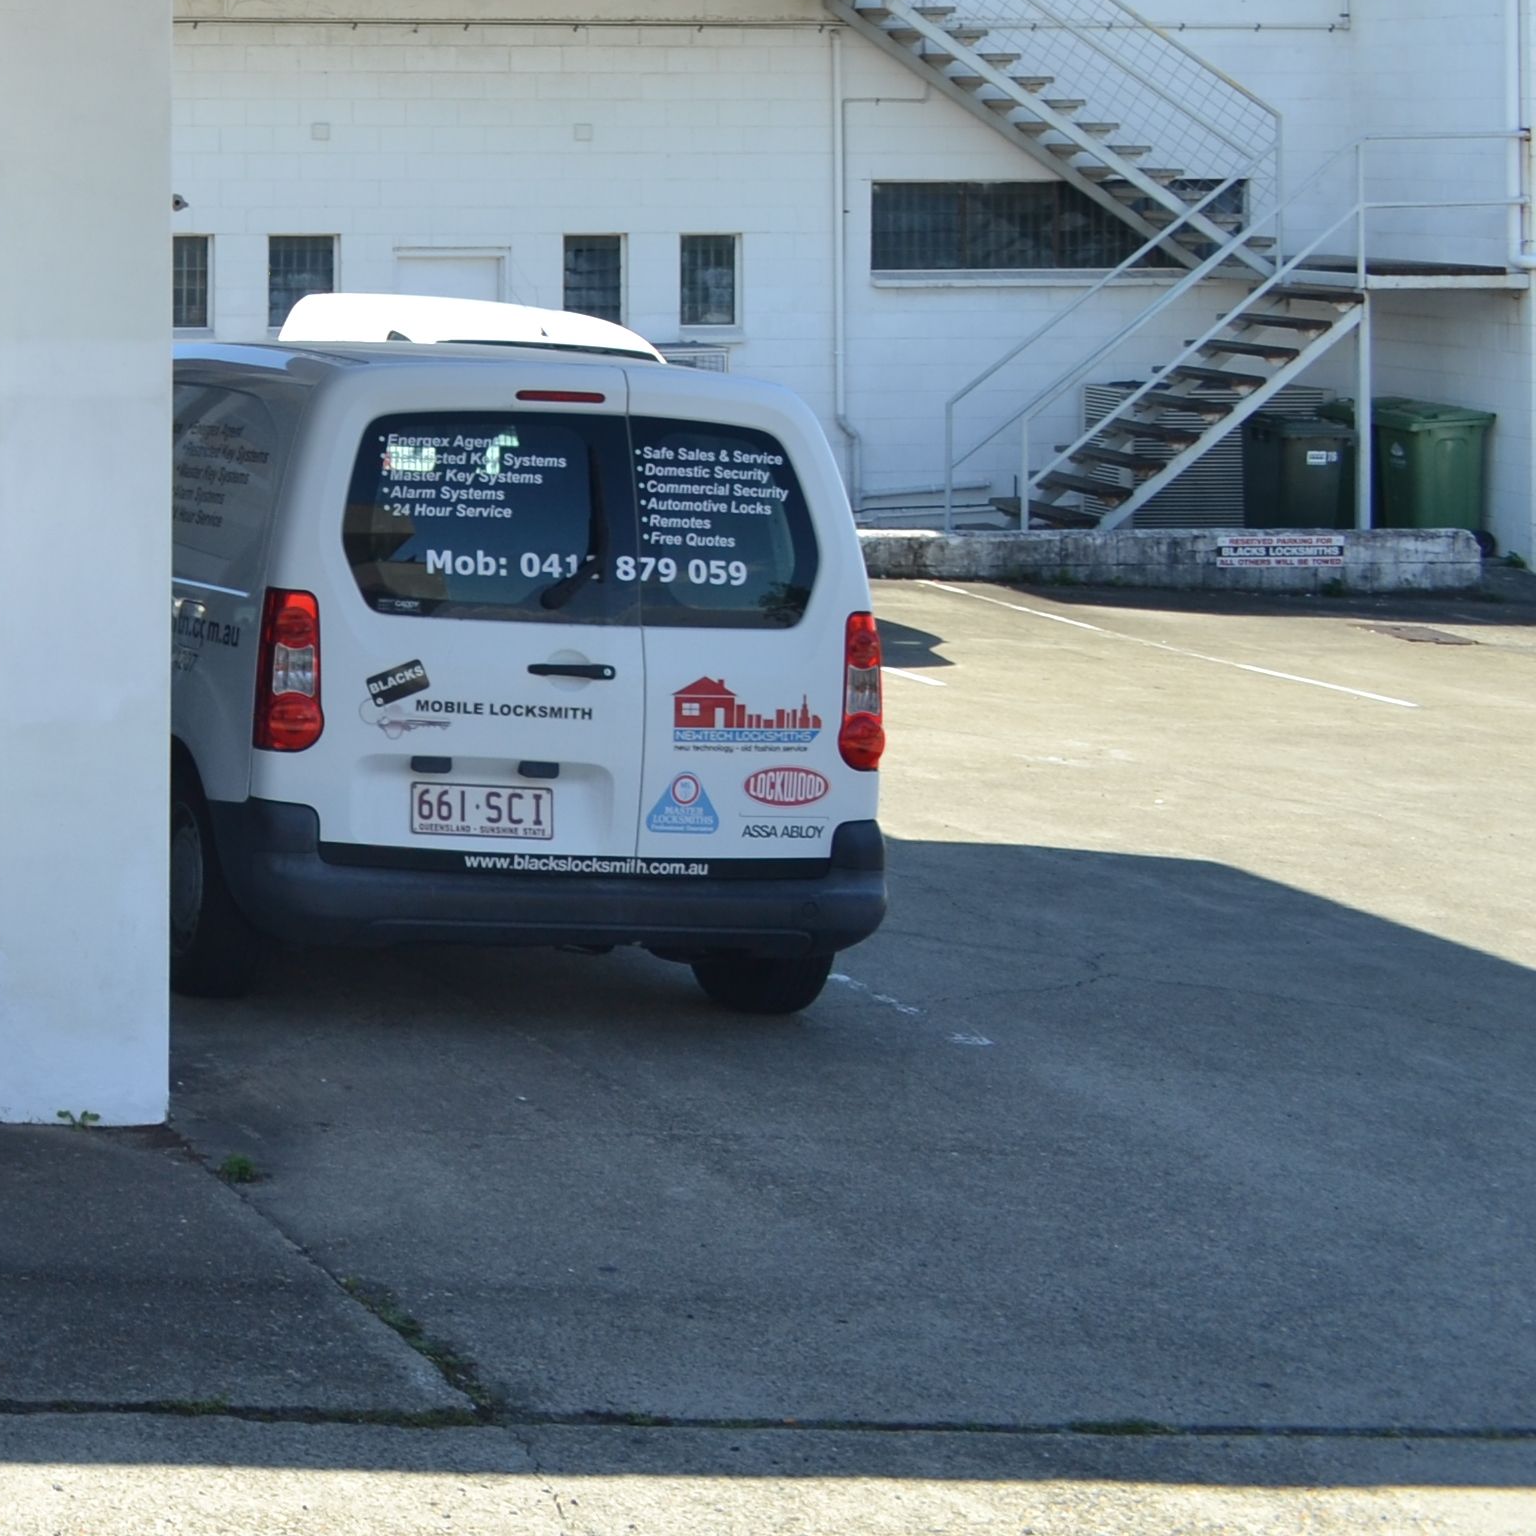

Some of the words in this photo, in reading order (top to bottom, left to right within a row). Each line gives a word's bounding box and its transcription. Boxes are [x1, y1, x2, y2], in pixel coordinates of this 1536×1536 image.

[387, 433, 450, 449] Energex
[503, 453, 568, 469] Systems
[642, 446, 675, 460] Safe
[677, 447, 716, 462] Sales
[718, 449, 730, 463] &
[732, 450, 784, 466] Service
[389, 468, 442, 482] Master
[445, 468, 476, 485] Key
[478, 469, 544, 486] Systems
[644, 463, 711, 478] Domestic
[713, 465, 771, 484] Security
[389, 485, 436, 499] Alarm
[439, 486, 506, 502] Systems
[646, 479, 730, 496] Commercial
[732, 483, 789, 502] Security
[392, 503, 411, 516] 24
[414, 503, 453, 517] Hour
[455, 504, 514, 518] Service
[647, 497, 728, 513] Automotive
[730, 500, 773, 516] Locks
[649, 514, 712, 530] Remotes
[650, 531, 683, 546] Free
[685, 532, 737, 548] Quotes
[1221, 547, 1266, 556] BLACKS
[1269, 547, 1340, 556] LOCKSMITHS
[426, 549, 508, 577] Mob:
[520, 551, 600, 580] 041
[615, 555, 678, 583] 879
[687, 559, 748, 586] 059
[369, 664, 425, 695] BLACKS
[415, 699, 484, 715] MOBILE
[489, 702, 593, 721] LOCKSMITH
[675, 730, 733, 741] NEWTECH
[735, 730, 812, 742] LOCKSMITHS
[693, 744, 734, 753] technology
[749, 770, 827, 802] LOCKWOOD
[418, 823, 471, 833] QUEENSLAND
[480, 825, 519, 836] SUNSHINE
[523, 827, 546, 837] STATE
[741, 824, 778, 838] ASSA
[780, 825, 826, 839] ABLOY
[464, 854, 709, 876] www.blackslocksmith.com.au
